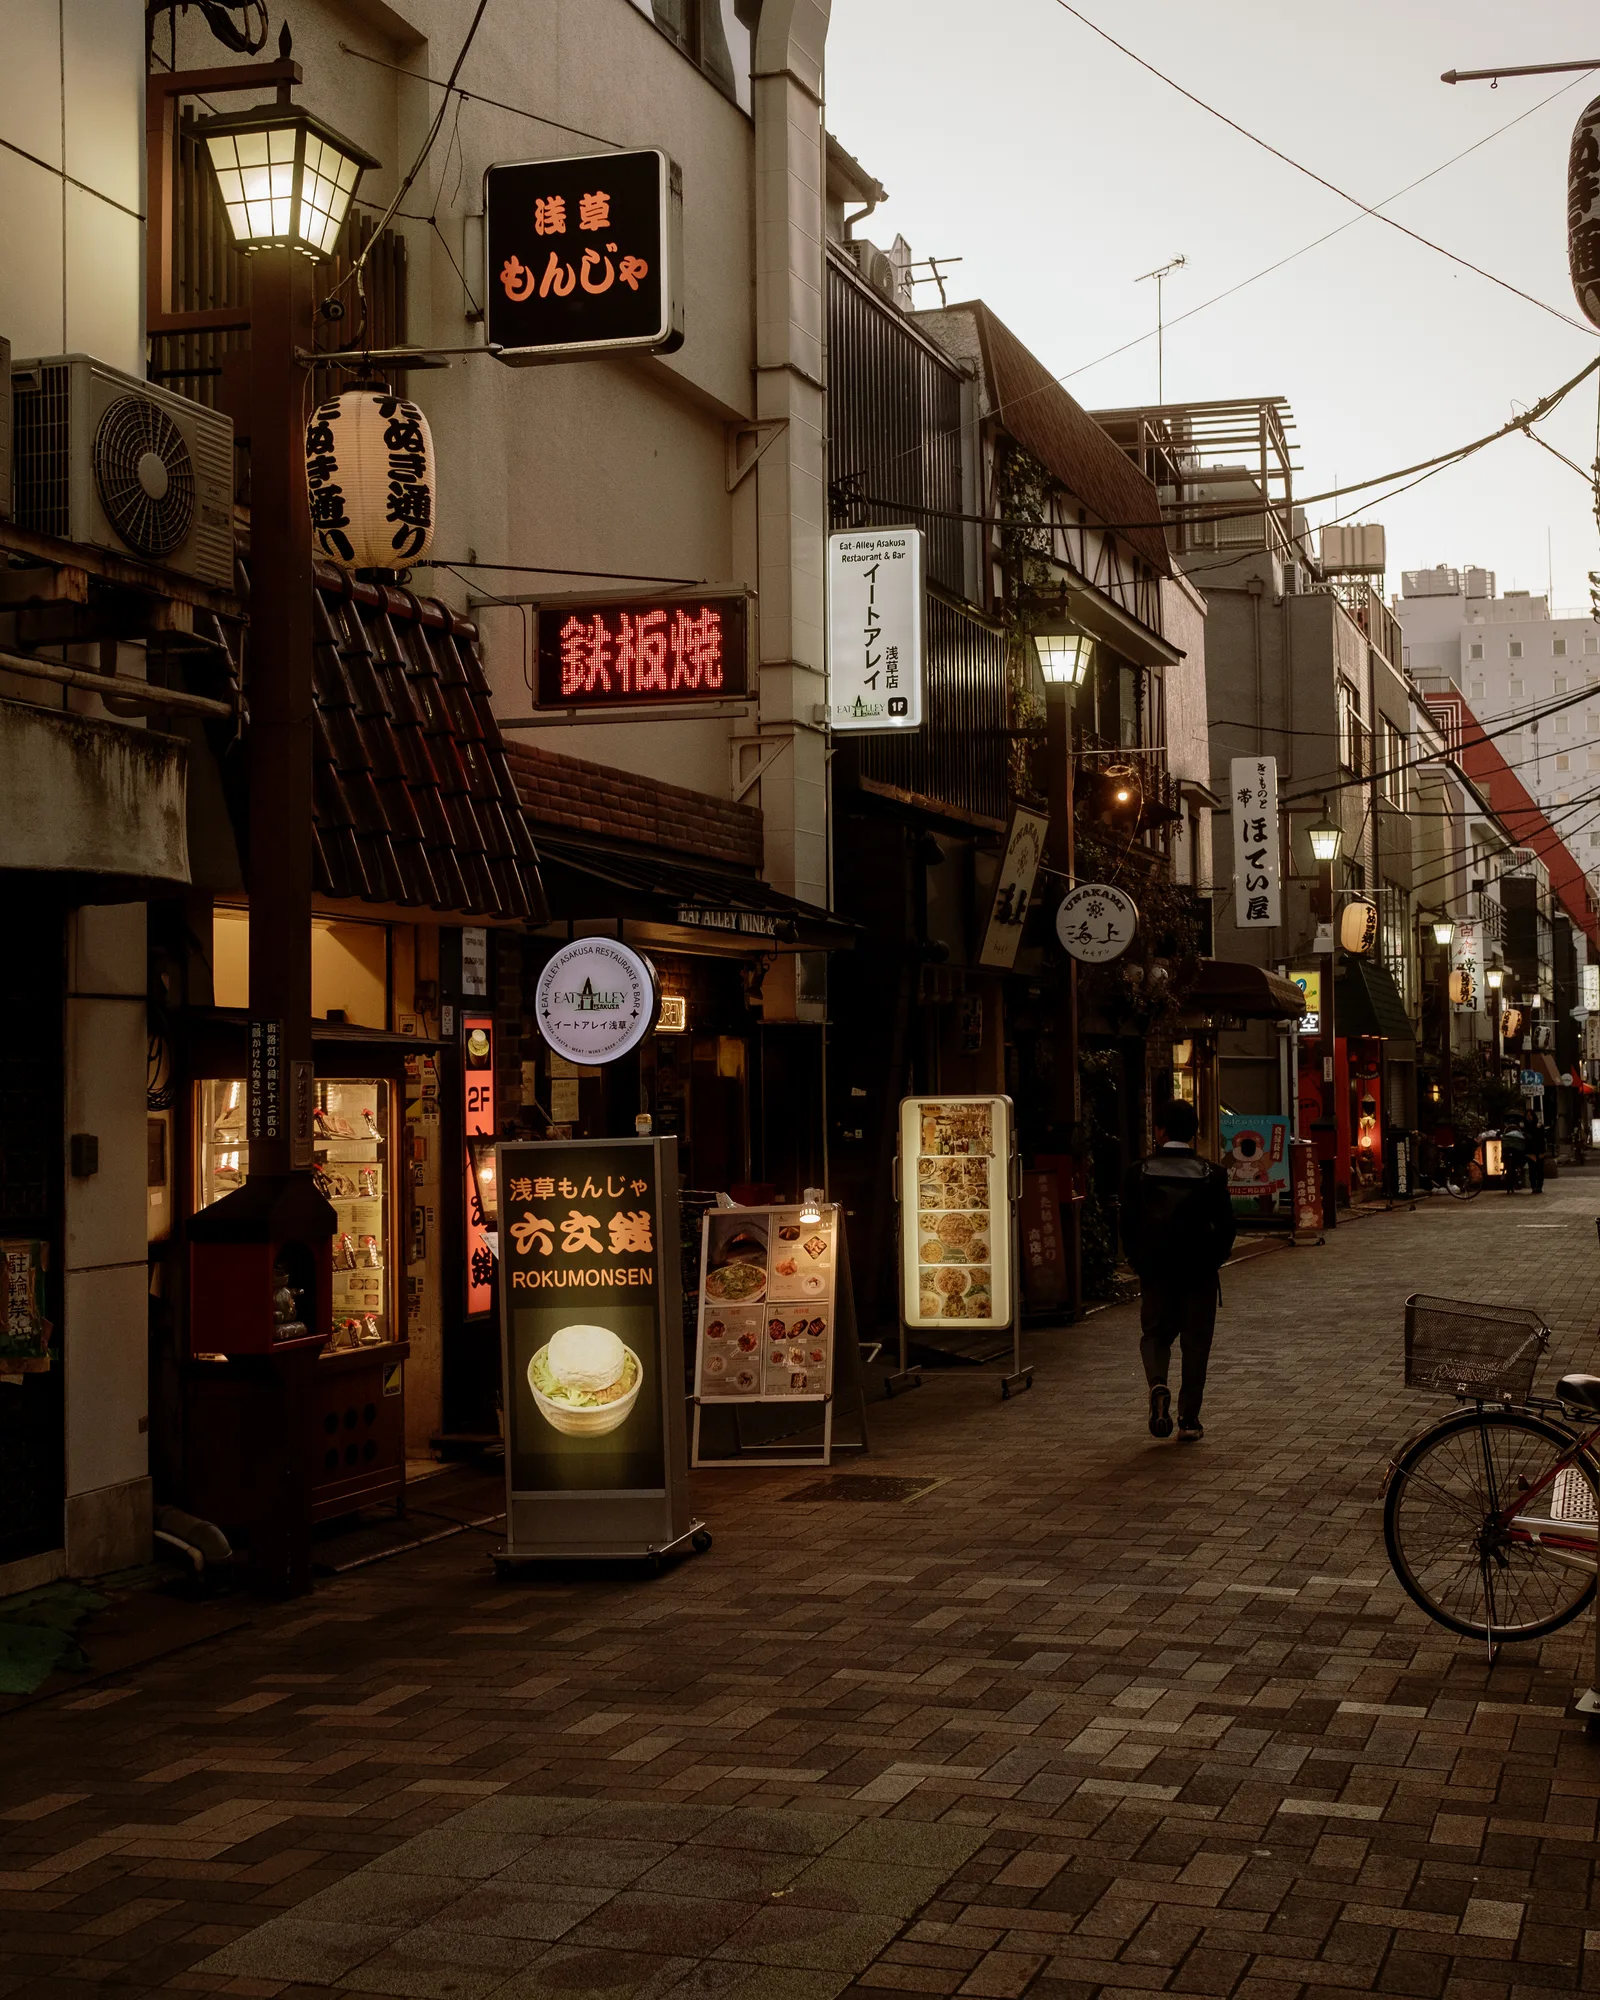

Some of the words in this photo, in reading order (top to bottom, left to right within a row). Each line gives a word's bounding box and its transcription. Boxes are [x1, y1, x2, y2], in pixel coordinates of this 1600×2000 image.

[534, 190, 610, 236] 浅草
[500, 242, 648, 302] もんじゃ
[372, 394, 432, 558] たぬき通り
[839, 540, 875, 551] Eat-Alley
[876, 538, 906, 548] Asakusa
[841, 552, 882, 563] Restaurant
[884, 552, 891, 560] &
[892, 551, 906, 560] Bar
[863, 563, 882, 691] イートアレイ
[560, 606, 723, 695] 鉄板焼
[885, 646, 899, 690] 浅草店
[891, 701, 904, 712] 1F
[1237, 788, 1252, 808] 帯
[1257, 763, 1268, 809] きものと
[1243, 816, 1269, 921] ほてい屋
[1064, 888, 1126, 912] UNAKAMI
[701, 911, 737, 930] ALLEY
[739, 912, 766, 934] WINE
[767, 914, 776, 936] &
[541, 963, 560, 1008] EAT-ALLEY
[560, 946, 594, 967] ASAKUSA
[595, 946, 637, 981] RESTAURANT
[633, 991, 641, 1009] BAR
[554, 1020, 627, 1030] イートアレイ浅草
[1299, 1012, 1319, 1032] 空
[555, 1035, 569, 1048] PASTA
[468, 1087, 490, 1112] 2F
[509, 1175, 648, 1202] 浅草もんじゃ
[509, 1210, 653, 1256] 六文銭
[512, 1267, 653, 1289] ROKUMONSEN
